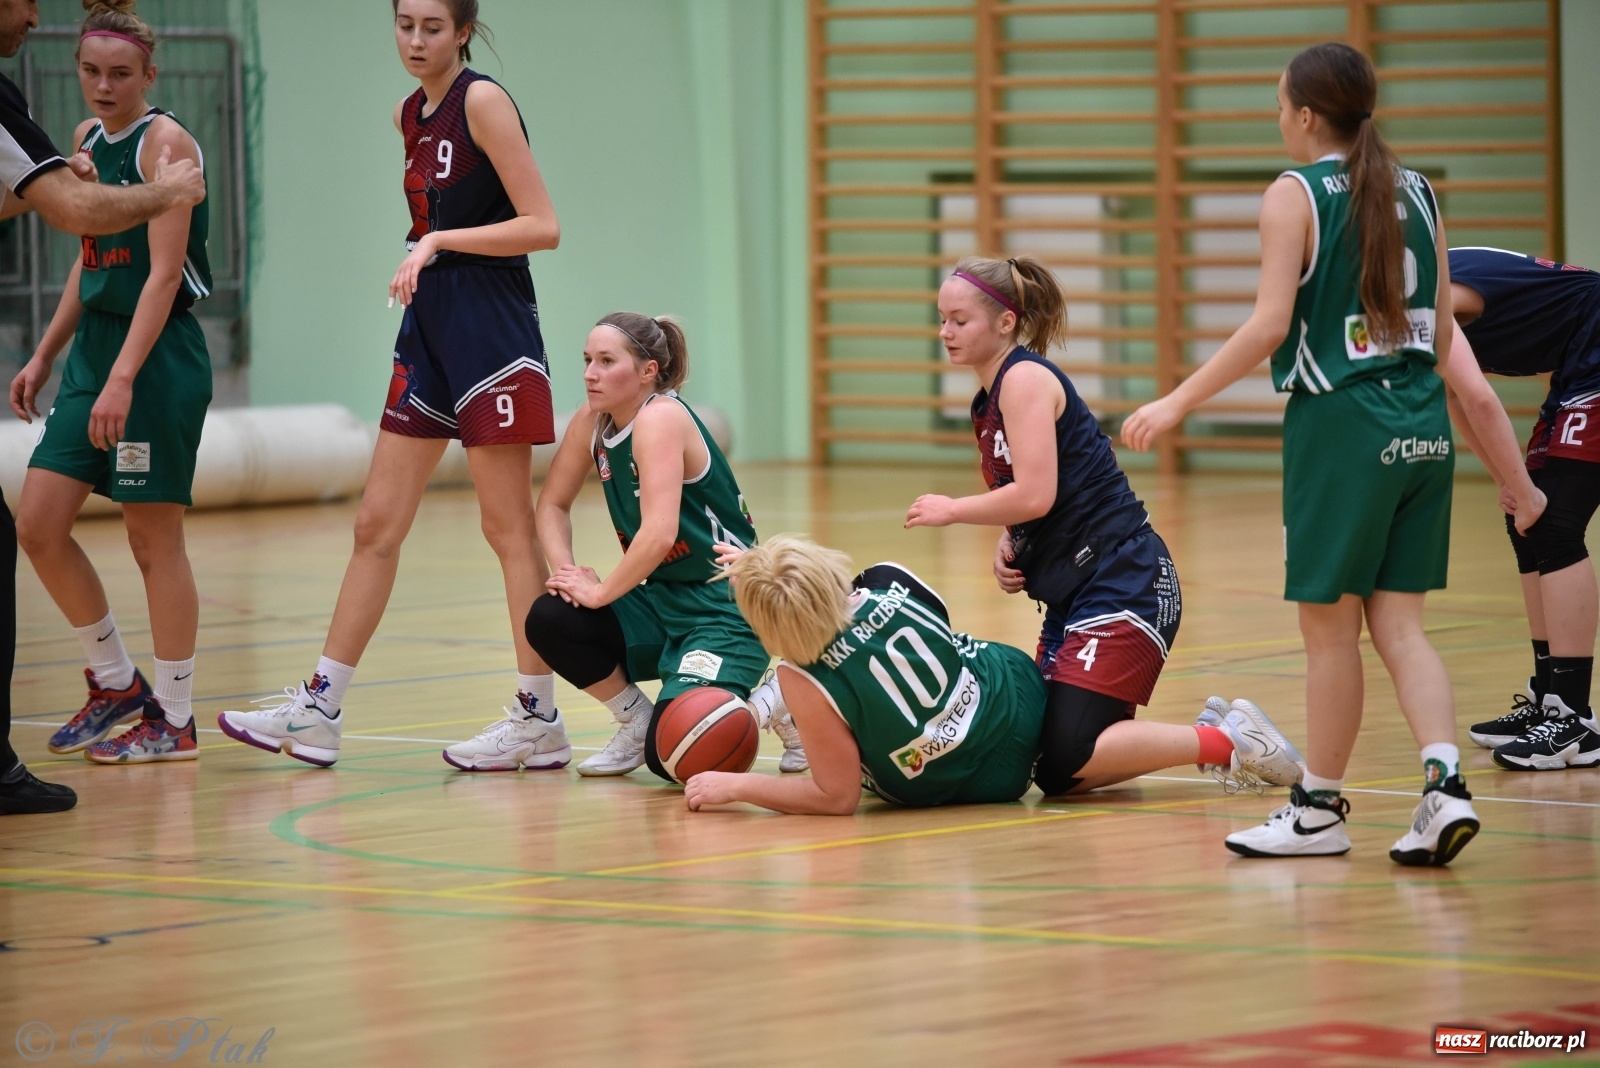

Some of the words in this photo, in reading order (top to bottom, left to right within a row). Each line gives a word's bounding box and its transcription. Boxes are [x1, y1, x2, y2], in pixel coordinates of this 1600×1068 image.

[436, 140, 453, 178] 9
[496, 394, 515, 428] 9
[1560, 413, 1588, 446] 12
[994, 429, 1012, 466] 4
[1401, 435, 1450, 459] Clavis
[820, 636, 857, 670] RKK
[1076, 638, 1099, 672] 4
[869, 626, 949, 728] 10
[922, 679, 977, 757] WAGTECH
